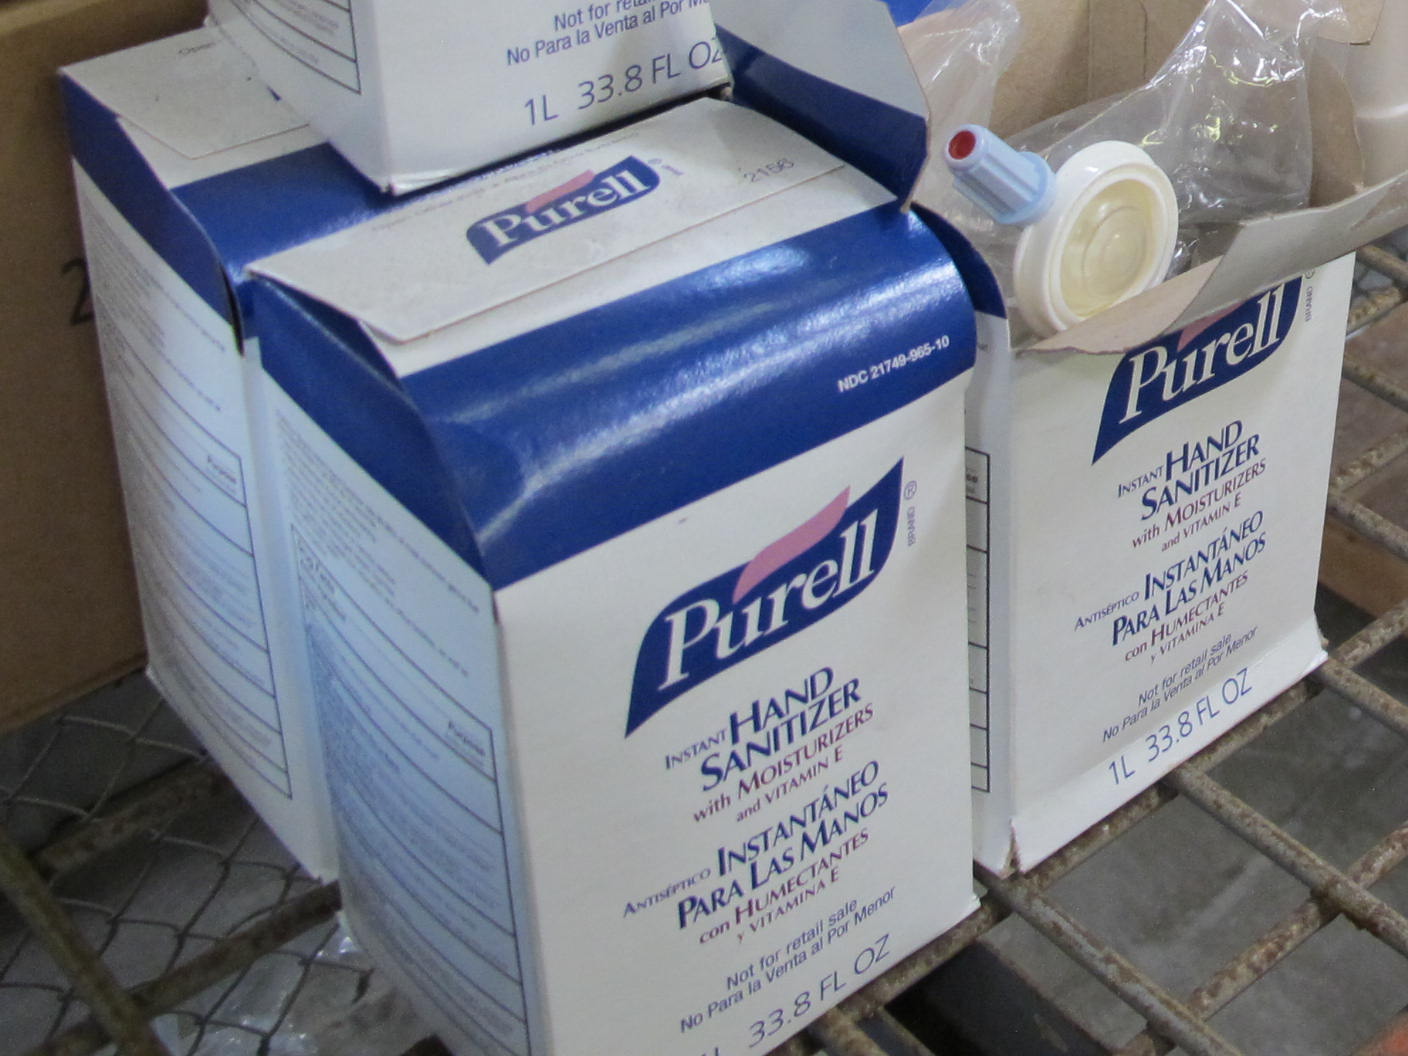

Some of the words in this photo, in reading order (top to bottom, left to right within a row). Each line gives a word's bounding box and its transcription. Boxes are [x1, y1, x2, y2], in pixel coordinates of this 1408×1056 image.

[507, 46, 530, 66] No
[535, 34, 572, 58] Para
[576, 29, 591, 46] la
[594, 14, 639, 40] Venta
[642, 3, 656, 24] al
[660, 0, 684, 19] Por
[554, 10, 583, 33] Not
[588, 3, 611, 22] for
[523, 95, 559, 127] 1L
[577, 64, 643, 110] 33.8
[652, 54, 680, 84] FL
[479, 169, 648, 247] Purell
[837, 370, 869, 393] NDC
[869, 335, 950, 381] 21749-965-10
[1119, 282, 1285, 425] Purell
[1118, 465, 1164, 498] INSTANT
[1165, 420, 1243, 482] HAND
[1132, 525, 1160, 550] with
[1164, 458, 1266, 532] MOISTURIZERS
[1141, 433, 1259, 521] SANITIZER
[1161, 535, 1180, 552] and
[1183, 507, 1232, 538] VITAMIN
[1234, 493, 1242, 508] E
[657, 507, 879, 692] Purell
[1074, 591, 1140, 631] ANTISÉPTICO
[1144, 510, 1264, 601] INSTANTÁNEO
[1112, 604, 1159, 646] PARA
[1165, 579, 1197, 617] LAS
[1200, 531, 1267, 594] MANOS
[1125, 642, 1148, 662] con
[1150, 570, 1249, 645] HUMECTANTES
[1137, 687, 1160, 706] Not
[1162, 672, 1178, 690] for
[1180, 651, 1209, 677] retail
[1210, 632, 1232, 654] sale
[1151, 651, 1157, 664] y
[1159, 615, 1215, 656] VITAMINA
[1217, 602, 1225, 616] E
[664, 728, 727, 771] INSTANT
[729, 666, 834, 747] HAND
[1102, 724, 1120, 743] No
[1121, 704, 1149, 729] Para
[1150, 696, 1161, 711] la
[1163, 675, 1193, 702] Venta
[1194, 663, 1205, 680] al
[1207, 649, 1226, 669] Por
[1226, 626, 1259, 657] Menor
[1108, 755, 1136, 786] 1L
[1144, 710, 1193, 763] 33.8
[1196, 696, 1220, 726] FL
[1221, 667, 1253, 704] OZ
[692, 794, 732, 823] with
[737, 702, 875, 799] MOISTURIZERS
[700, 677, 861, 792] SANITIZER
[736, 798, 762, 823] and
[763, 759, 830, 806] VITAMIN
[834, 745, 844, 763] E
[623, 868, 712, 919] ANTISÉPTICO
[717, 760, 879, 877] INSTANTÁNEO
[677, 879, 745, 930] PARA
[750, 847, 795, 891] LAS
[800, 782, 889, 862] MANOS
[699, 921, 731, 944] con
[734, 827, 870, 925] HUMECTANTES
[726, 965, 756, 991] Not
[759, 947, 782, 972] for
[785, 916, 825, 954] retail
[828, 897, 859, 927] sale
[736, 930, 745, 944] y
[748, 883, 828, 934] VITAMINA
[830, 867, 841, 883] E
[679, 1012, 704, 1034] No
[707, 988, 744, 1018] Para
[747, 978, 762, 996] la
[765, 952, 808, 984] Venta
[810, 939, 824, 956] al
[827, 922, 851, 947] Por
[854, 885, 896, 928] Menor
[748, 990, 811, 1049] 33.8
[820, 971, 847, 1002] FL
[854, 933, 890, 976] OZ
